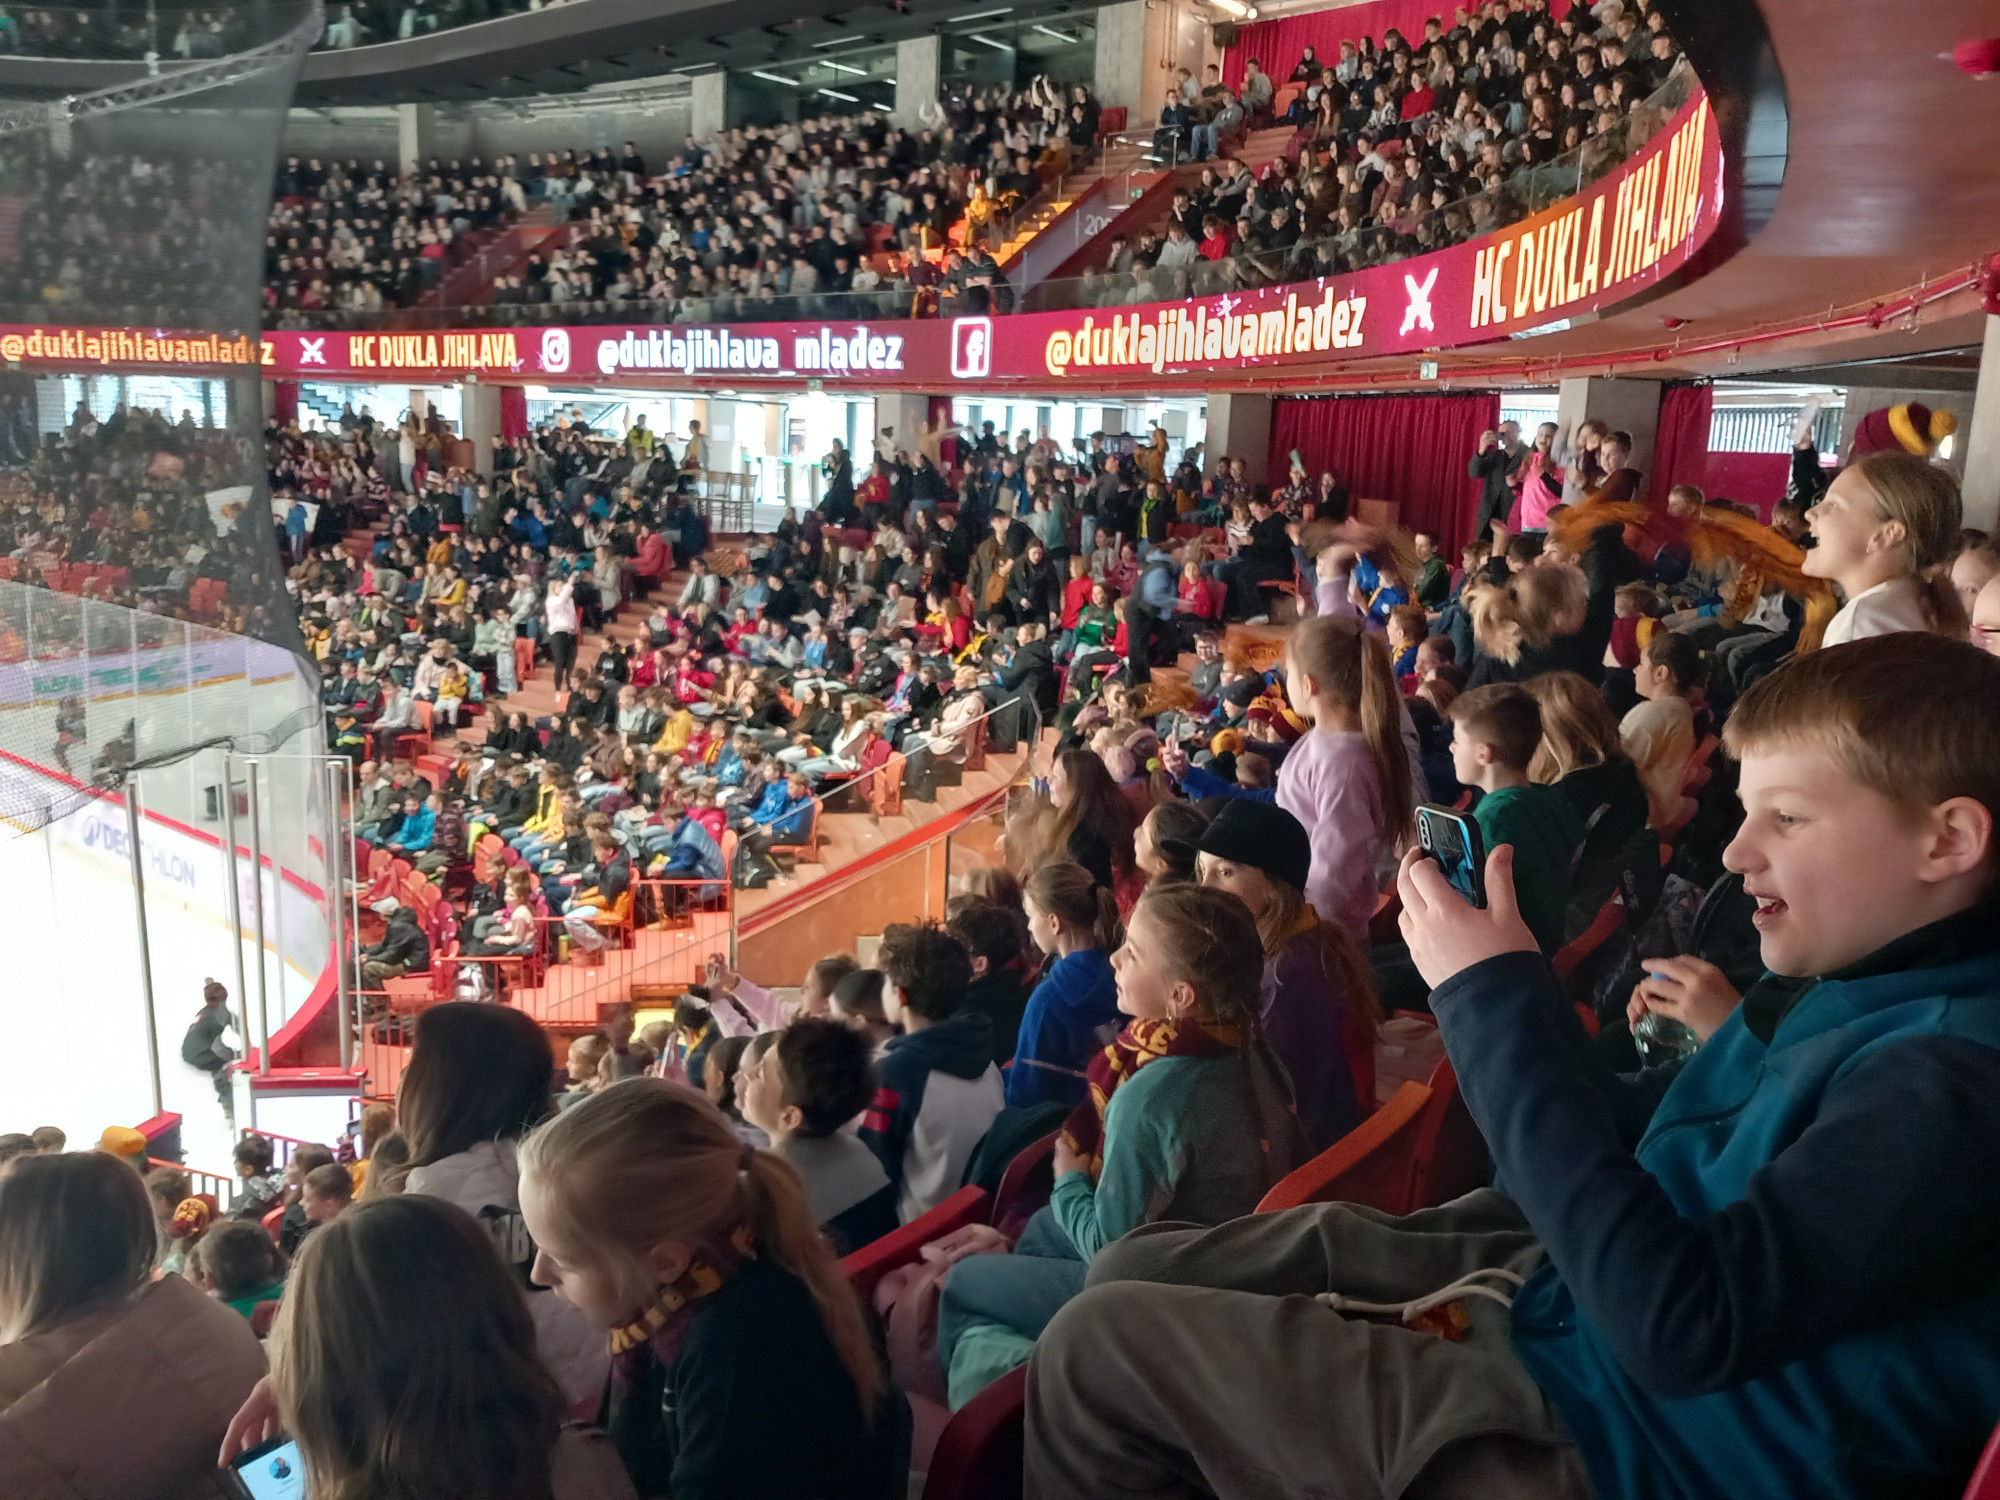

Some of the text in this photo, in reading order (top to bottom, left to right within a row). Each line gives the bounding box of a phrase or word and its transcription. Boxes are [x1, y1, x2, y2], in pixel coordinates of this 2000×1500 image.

[1470, 96, 1708, 328] HC DUKLA JIHLAVA
[349, 333, 517, 368] HC DUKLA JIHLAVA
[1046, 286, 1367, 376] @duklajihlavamladez
[103, 823, 195, 888] DECHLON
